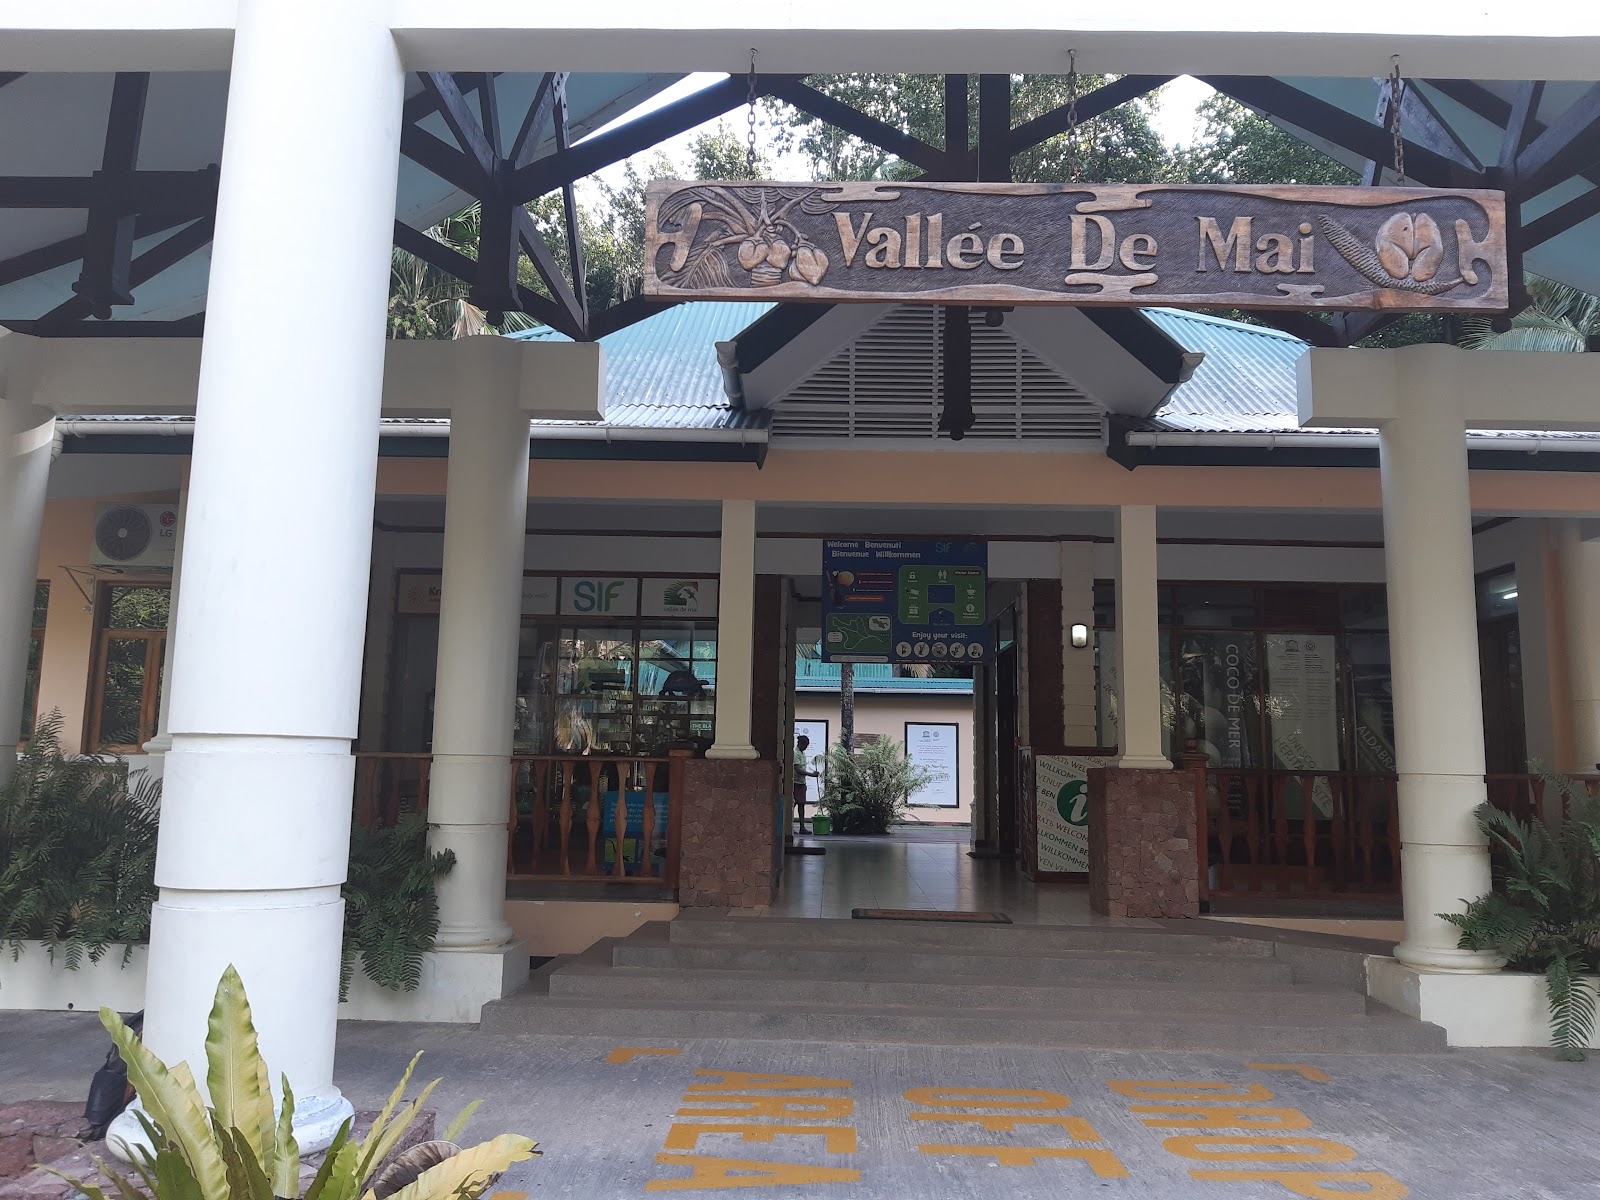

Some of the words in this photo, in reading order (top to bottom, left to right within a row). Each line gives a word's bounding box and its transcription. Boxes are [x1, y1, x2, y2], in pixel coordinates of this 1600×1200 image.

[832, 212, 1025, 270] Vallée
[1067, 214, 1159, 271] De
[1195, 215, 1316, 274] Mai
[160, 529, 173, 538] LG
[827, 540, 859, 549] Welcome
[865, 541, 902, 549] Benvenuti
[832, 550, 870, 558] Bienvenue
[875, 551, 921, 559] Willkommen
[573, 580, 625, 613] SIF
[912, 631, 931, 640] Enjoy
[933, 632, 949, 640] your
[950, 631, 968, 639] visit:
[1226, 644, 1240, 689] COCO
[1227, 694, 1241, 712] DE
[1228, 717, 1241, 748] MER
[1357, 725, 1397, 771] ALDABRA
[1287, 733, 1316, 769] UNESCO
[646, 1069, 862, 1192] AREA
[903, 1087, 1131, 1179] OFF
[1106, 1077, 1412, 1200] DROP
